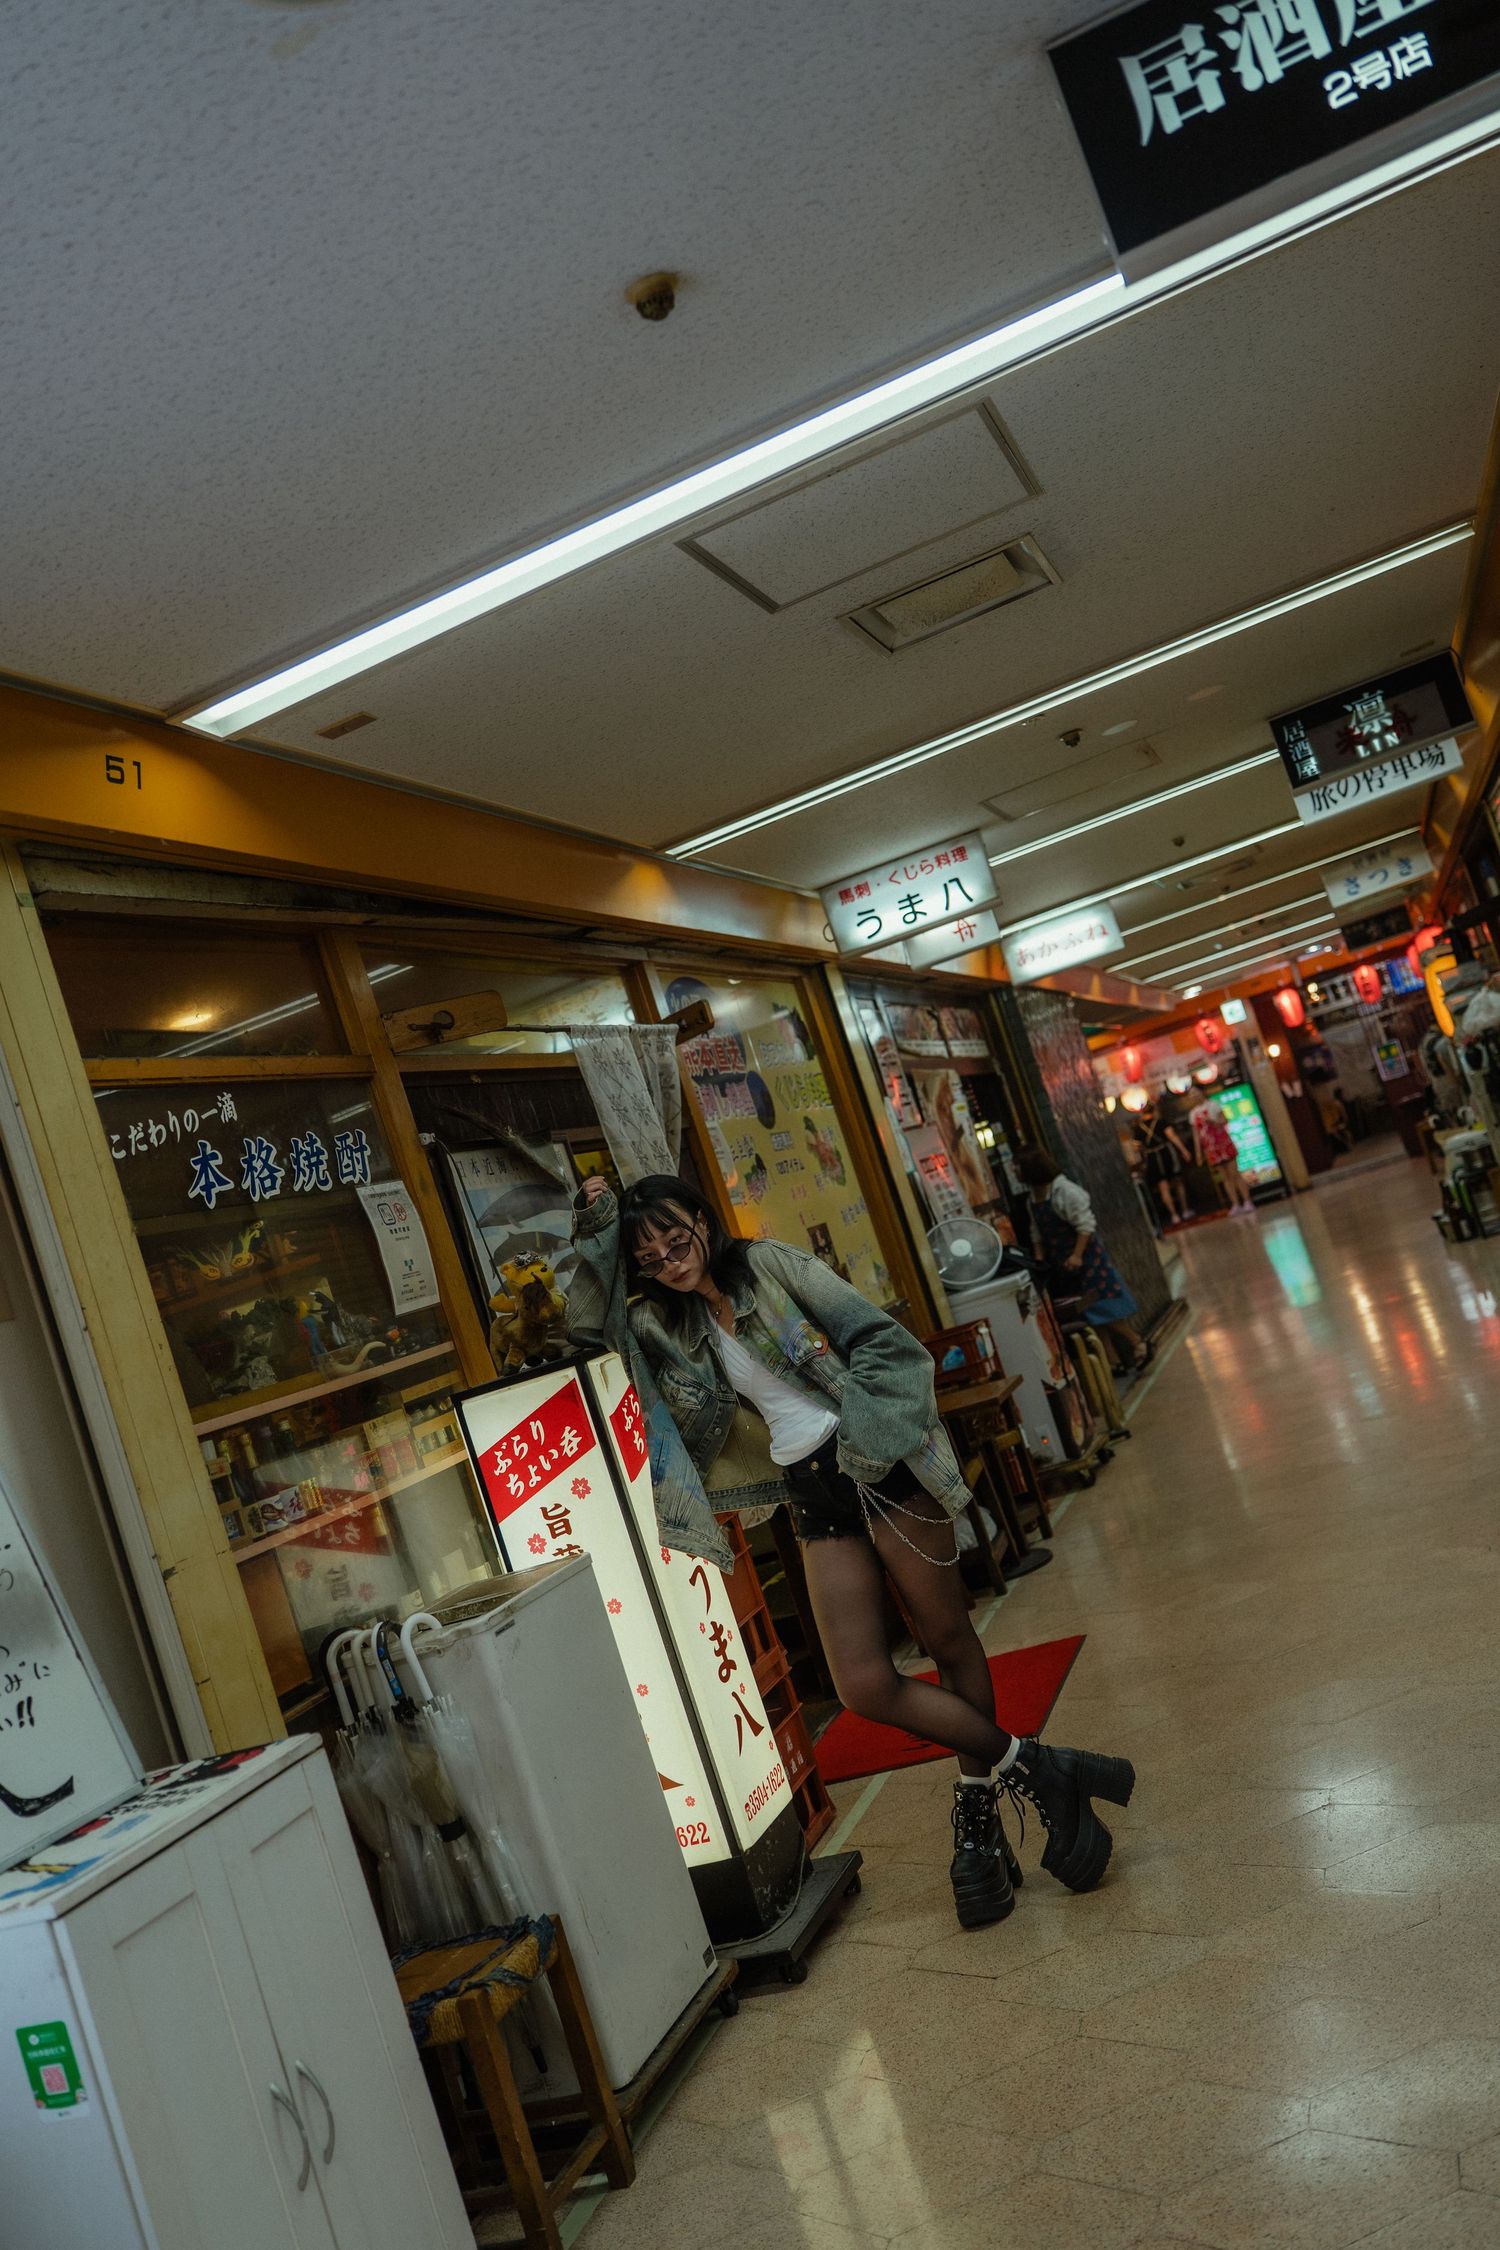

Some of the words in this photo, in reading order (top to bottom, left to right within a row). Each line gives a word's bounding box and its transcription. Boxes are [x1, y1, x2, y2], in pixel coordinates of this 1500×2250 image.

[1322, 32, 1435, 110] 2号店
[105, 753, 142, 790] 51
[1283, 720, 1320, 780] 居酒屋
[1355, 731, 1401, 759] LIN
[1345, 857, 1412, 896] さつき
[856, 877, 974, 939] うま八
[110, 1091, 238, 1160] こだわりの一滴
[187, 1128, 371, 1210] 本格焼酎
[494, 1419, 546, 1477] ぶらり
[686, 1553, 765, 1757] うま八
[676, 1822, 710, 1848] 622
